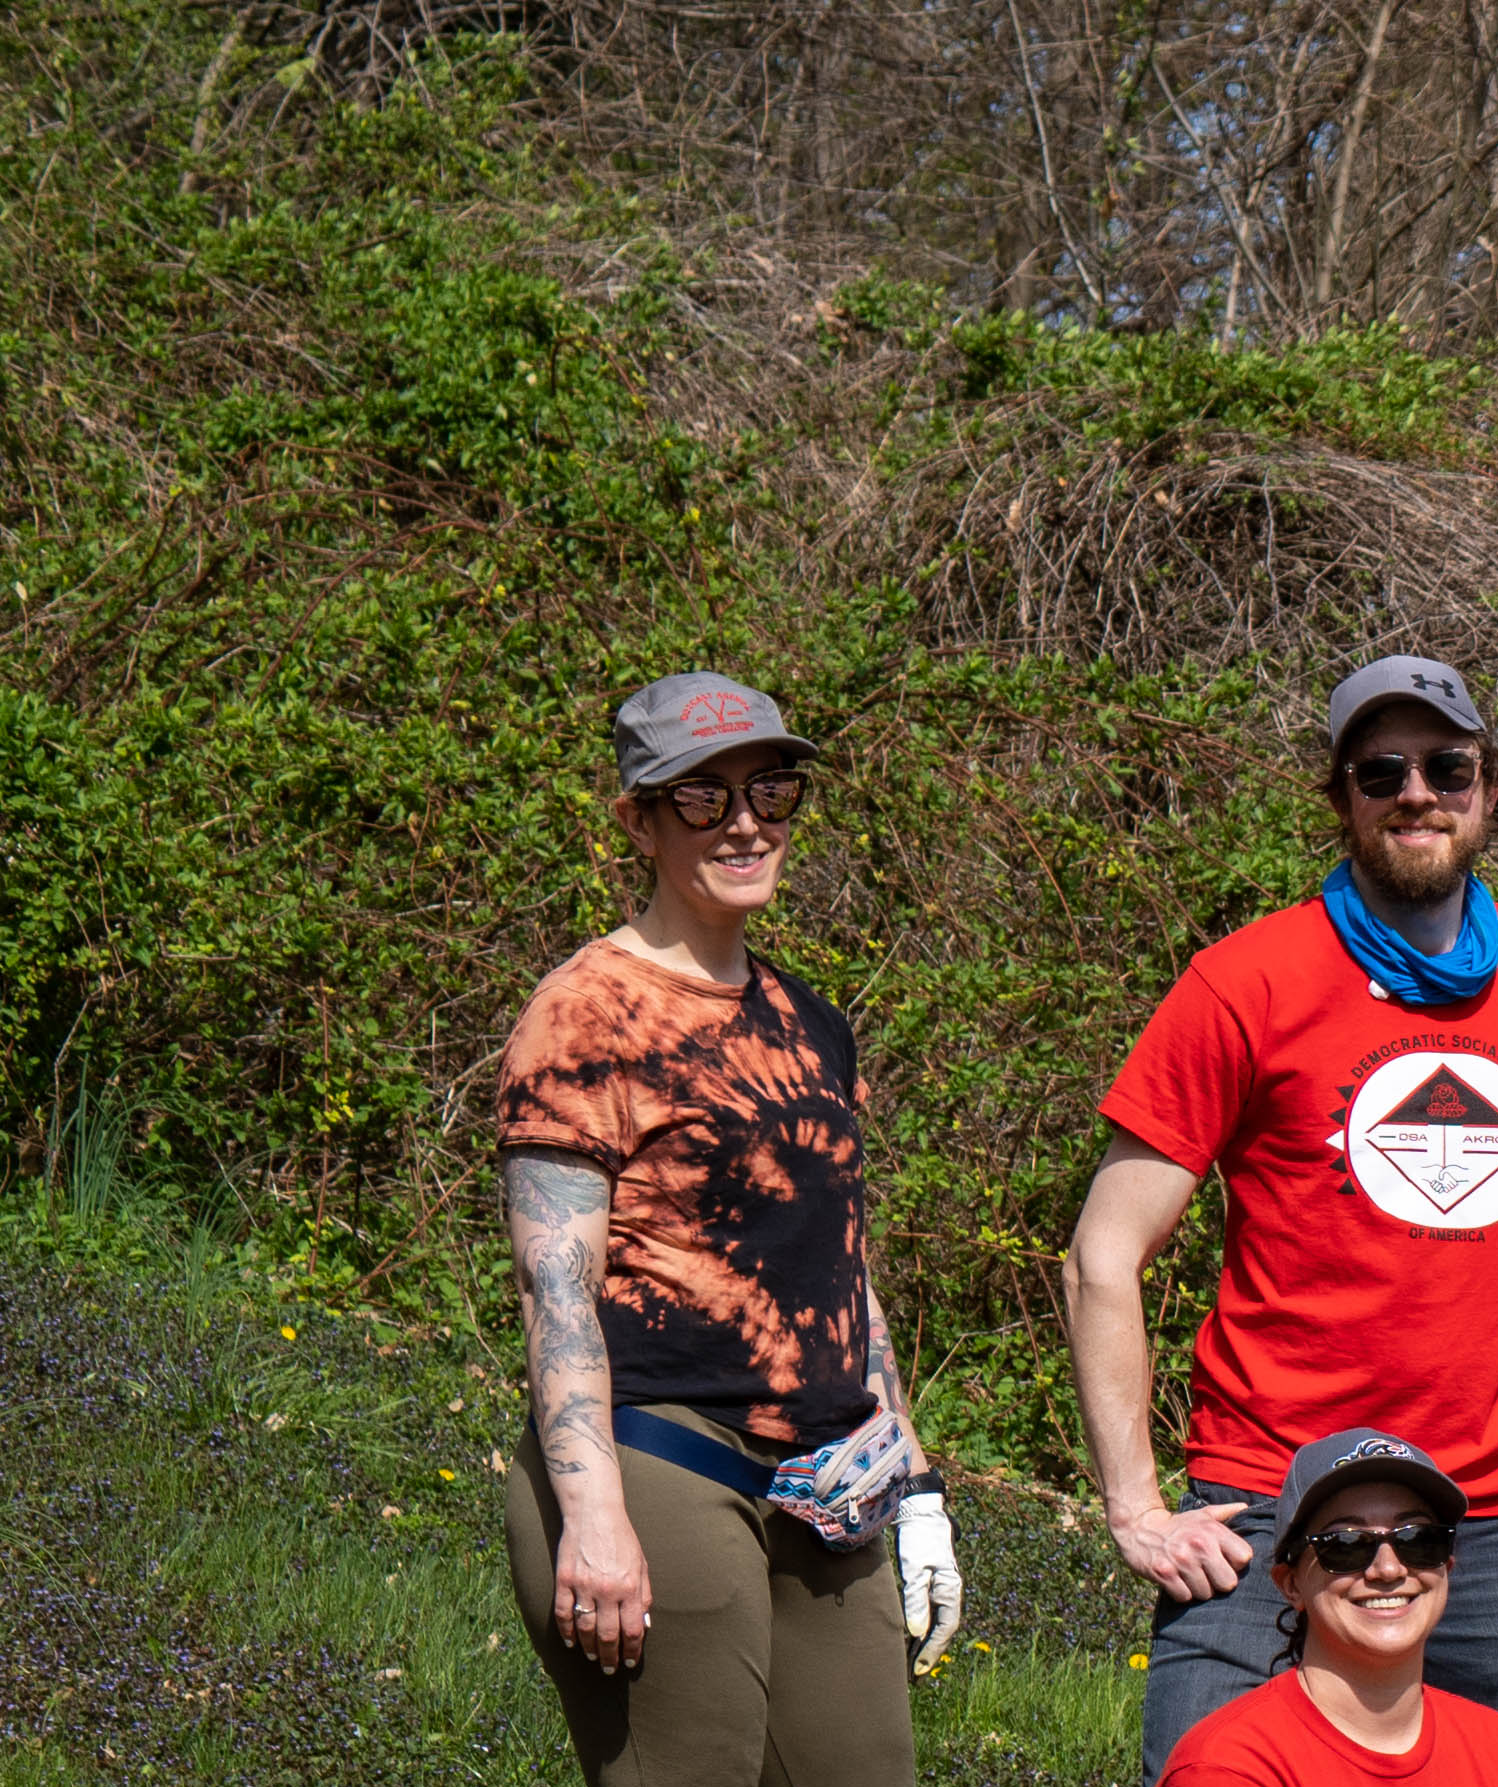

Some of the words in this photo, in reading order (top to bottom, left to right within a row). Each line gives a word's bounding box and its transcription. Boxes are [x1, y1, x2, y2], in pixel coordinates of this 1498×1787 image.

[1350, 1034, 1446, 1079] DEMOCRATIC
[1399, 1132, 1428, 1142] DSA
[1409, 1227, 1425, 1241] OF
[1428, 1227, 1486, 1243] AMERICA
